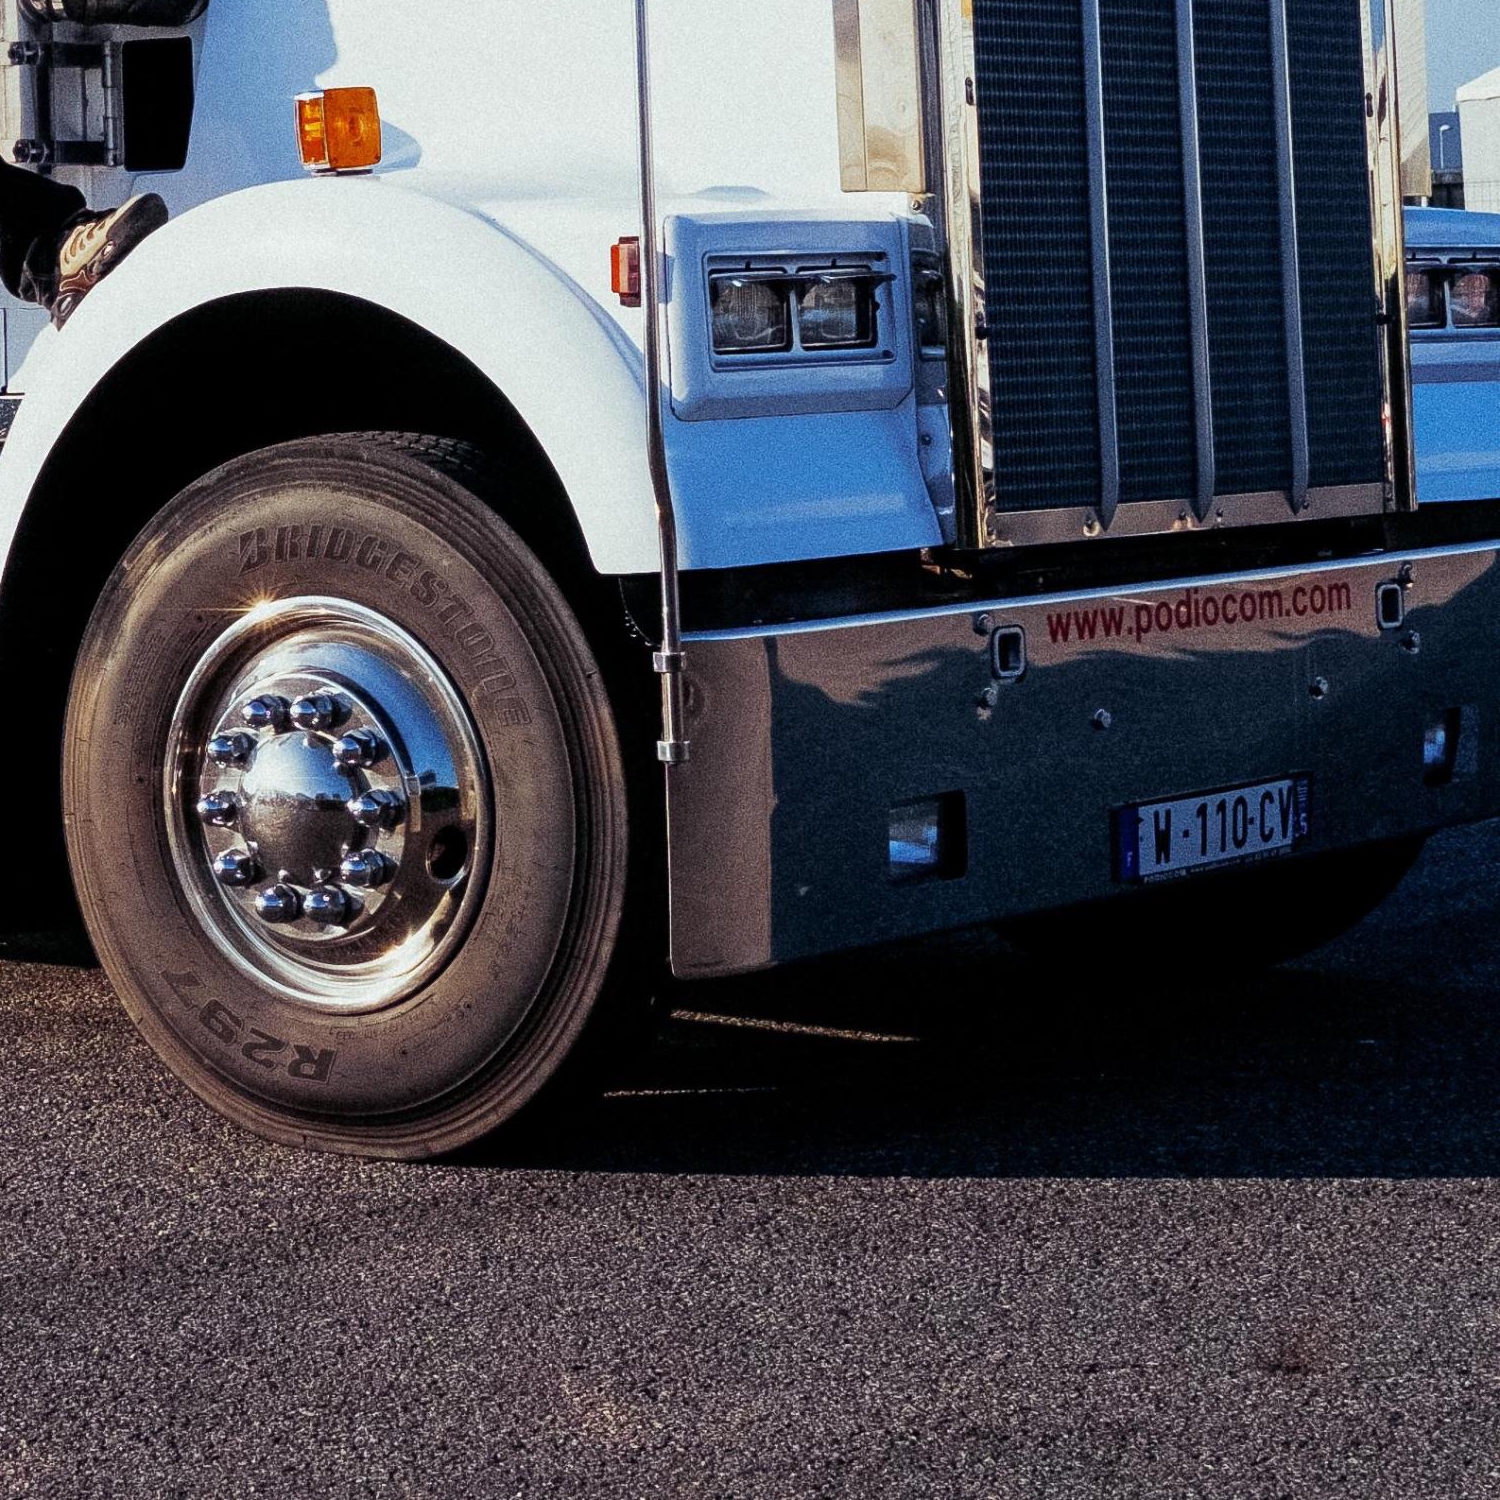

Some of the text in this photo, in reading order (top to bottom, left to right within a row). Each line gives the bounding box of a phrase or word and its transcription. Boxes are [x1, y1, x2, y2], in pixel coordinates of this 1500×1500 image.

[237, 526, 533, 727] BRIDGESTONE
[1047, 581, 1351, 644] www.podiocom.com
[160, 967, 338, 1084] R297
